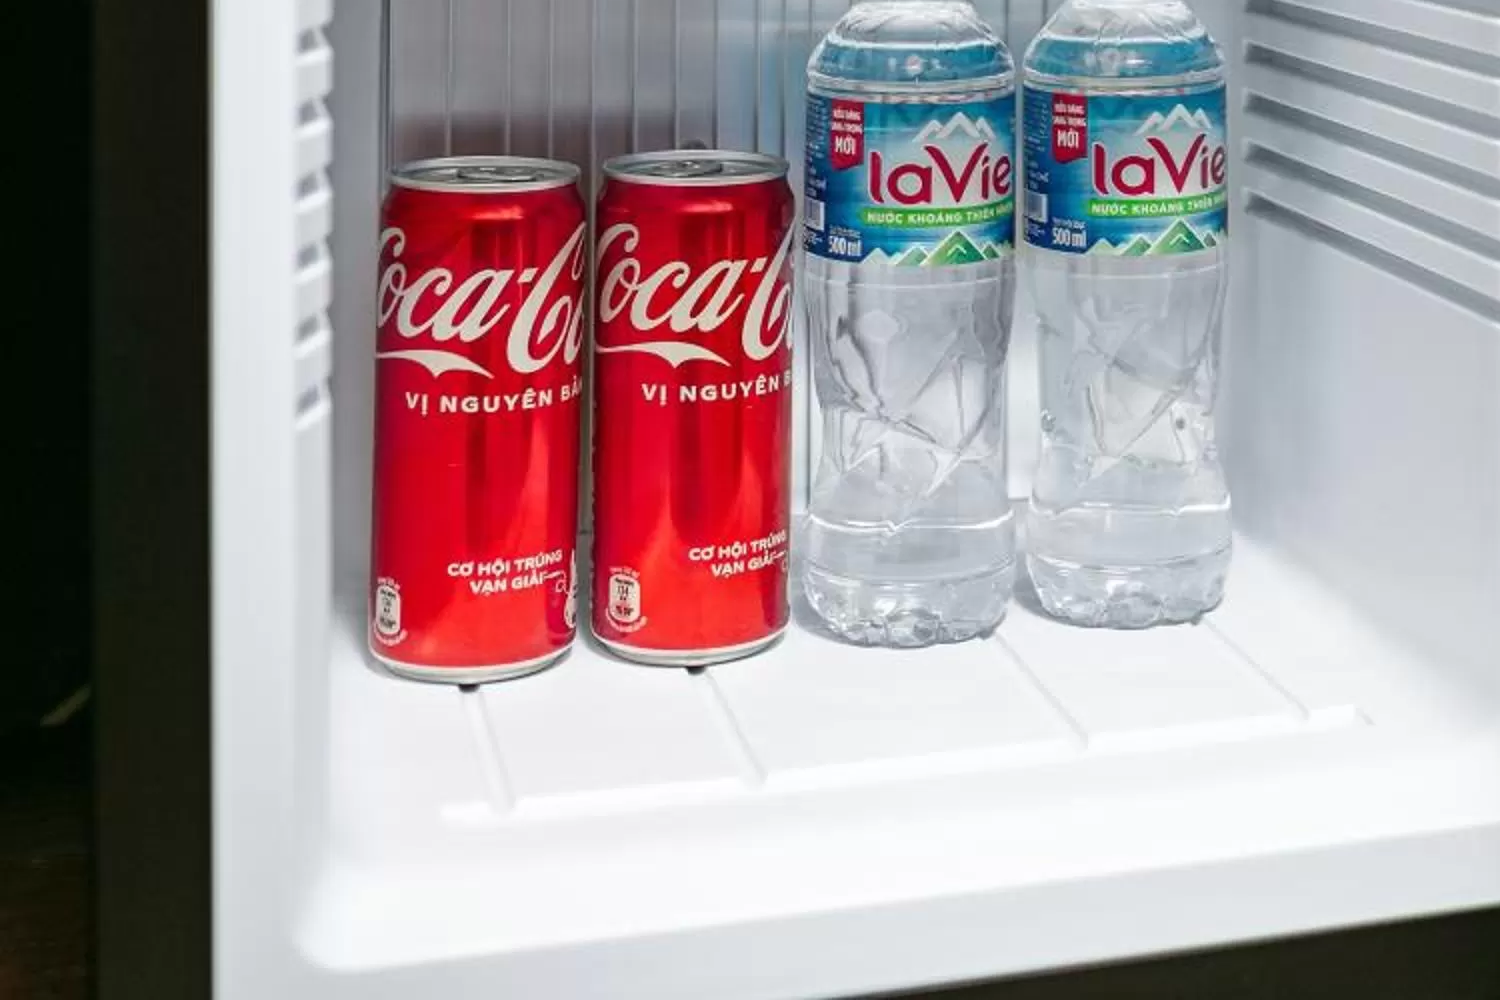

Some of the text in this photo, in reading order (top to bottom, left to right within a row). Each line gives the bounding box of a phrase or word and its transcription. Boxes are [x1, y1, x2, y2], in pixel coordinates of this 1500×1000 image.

[869, 141, 1011, 206] laVie
[1093, 133, 1225, 196] laVie
[405, 375, 583, 417] VỊ NGUYÊN BẢ
[641, 383, 667, 406] VỊ
[679, 374, 779, 403] NGUYÊN
[688, 544, 715, 560] CƠ
[718, 540, 747, 560] HỘI
[447, 561, 475, 577] CƠ
[477, 557, 511, 577] HỘI
[711, 560, 745, 579] VẠN
[470, 579, 507, 597] VẠN
